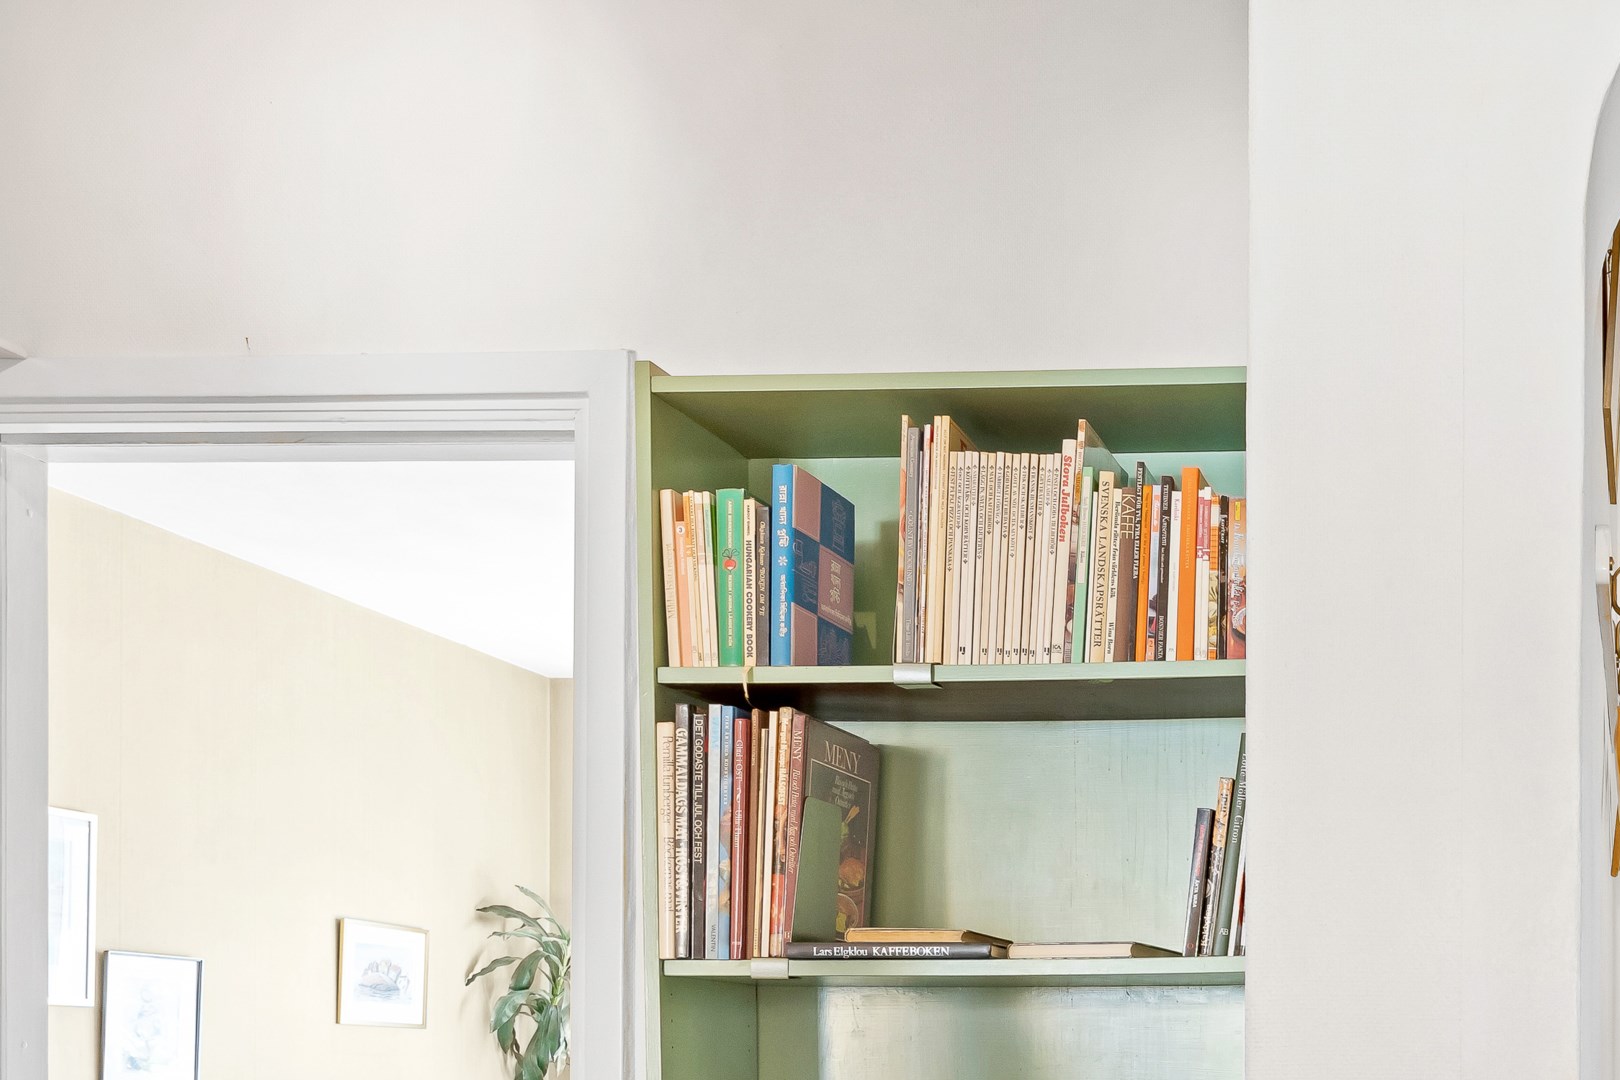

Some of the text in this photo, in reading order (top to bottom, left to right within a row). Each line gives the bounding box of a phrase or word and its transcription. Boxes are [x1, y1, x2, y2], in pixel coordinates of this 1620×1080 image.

[1060, 455, 1072, 542] Stora Julboken
[1122, 494, 1136, 540] KAFFE
[758, 566, 766, 592] BOKEN
[1094, 480, 1110, 648] SVENSKA LANDSKAPSRÄTTER
[1110, 562, 1118, 586] världens
[759, 606, 766, 616] TE
[760, 594, 766, 604] OM
[736, 740, 744, 758] Glad
[792, 730, 802, 762] MENY
[824, 740, 861, 774] MENY
[660, 736, 674, 826] Pernilla Tunberger
[676, 728, 688, 814] GAMMALDAGS
[694, 720, 704, 864] DET GODASTE TILL JUL OCH FEST
[676, 816, 688, 842] MAT
[1232, 814, 1242, 844] Citron
[813, 946, 950, 958] Lars Elgklou KAFFEBOKEN
